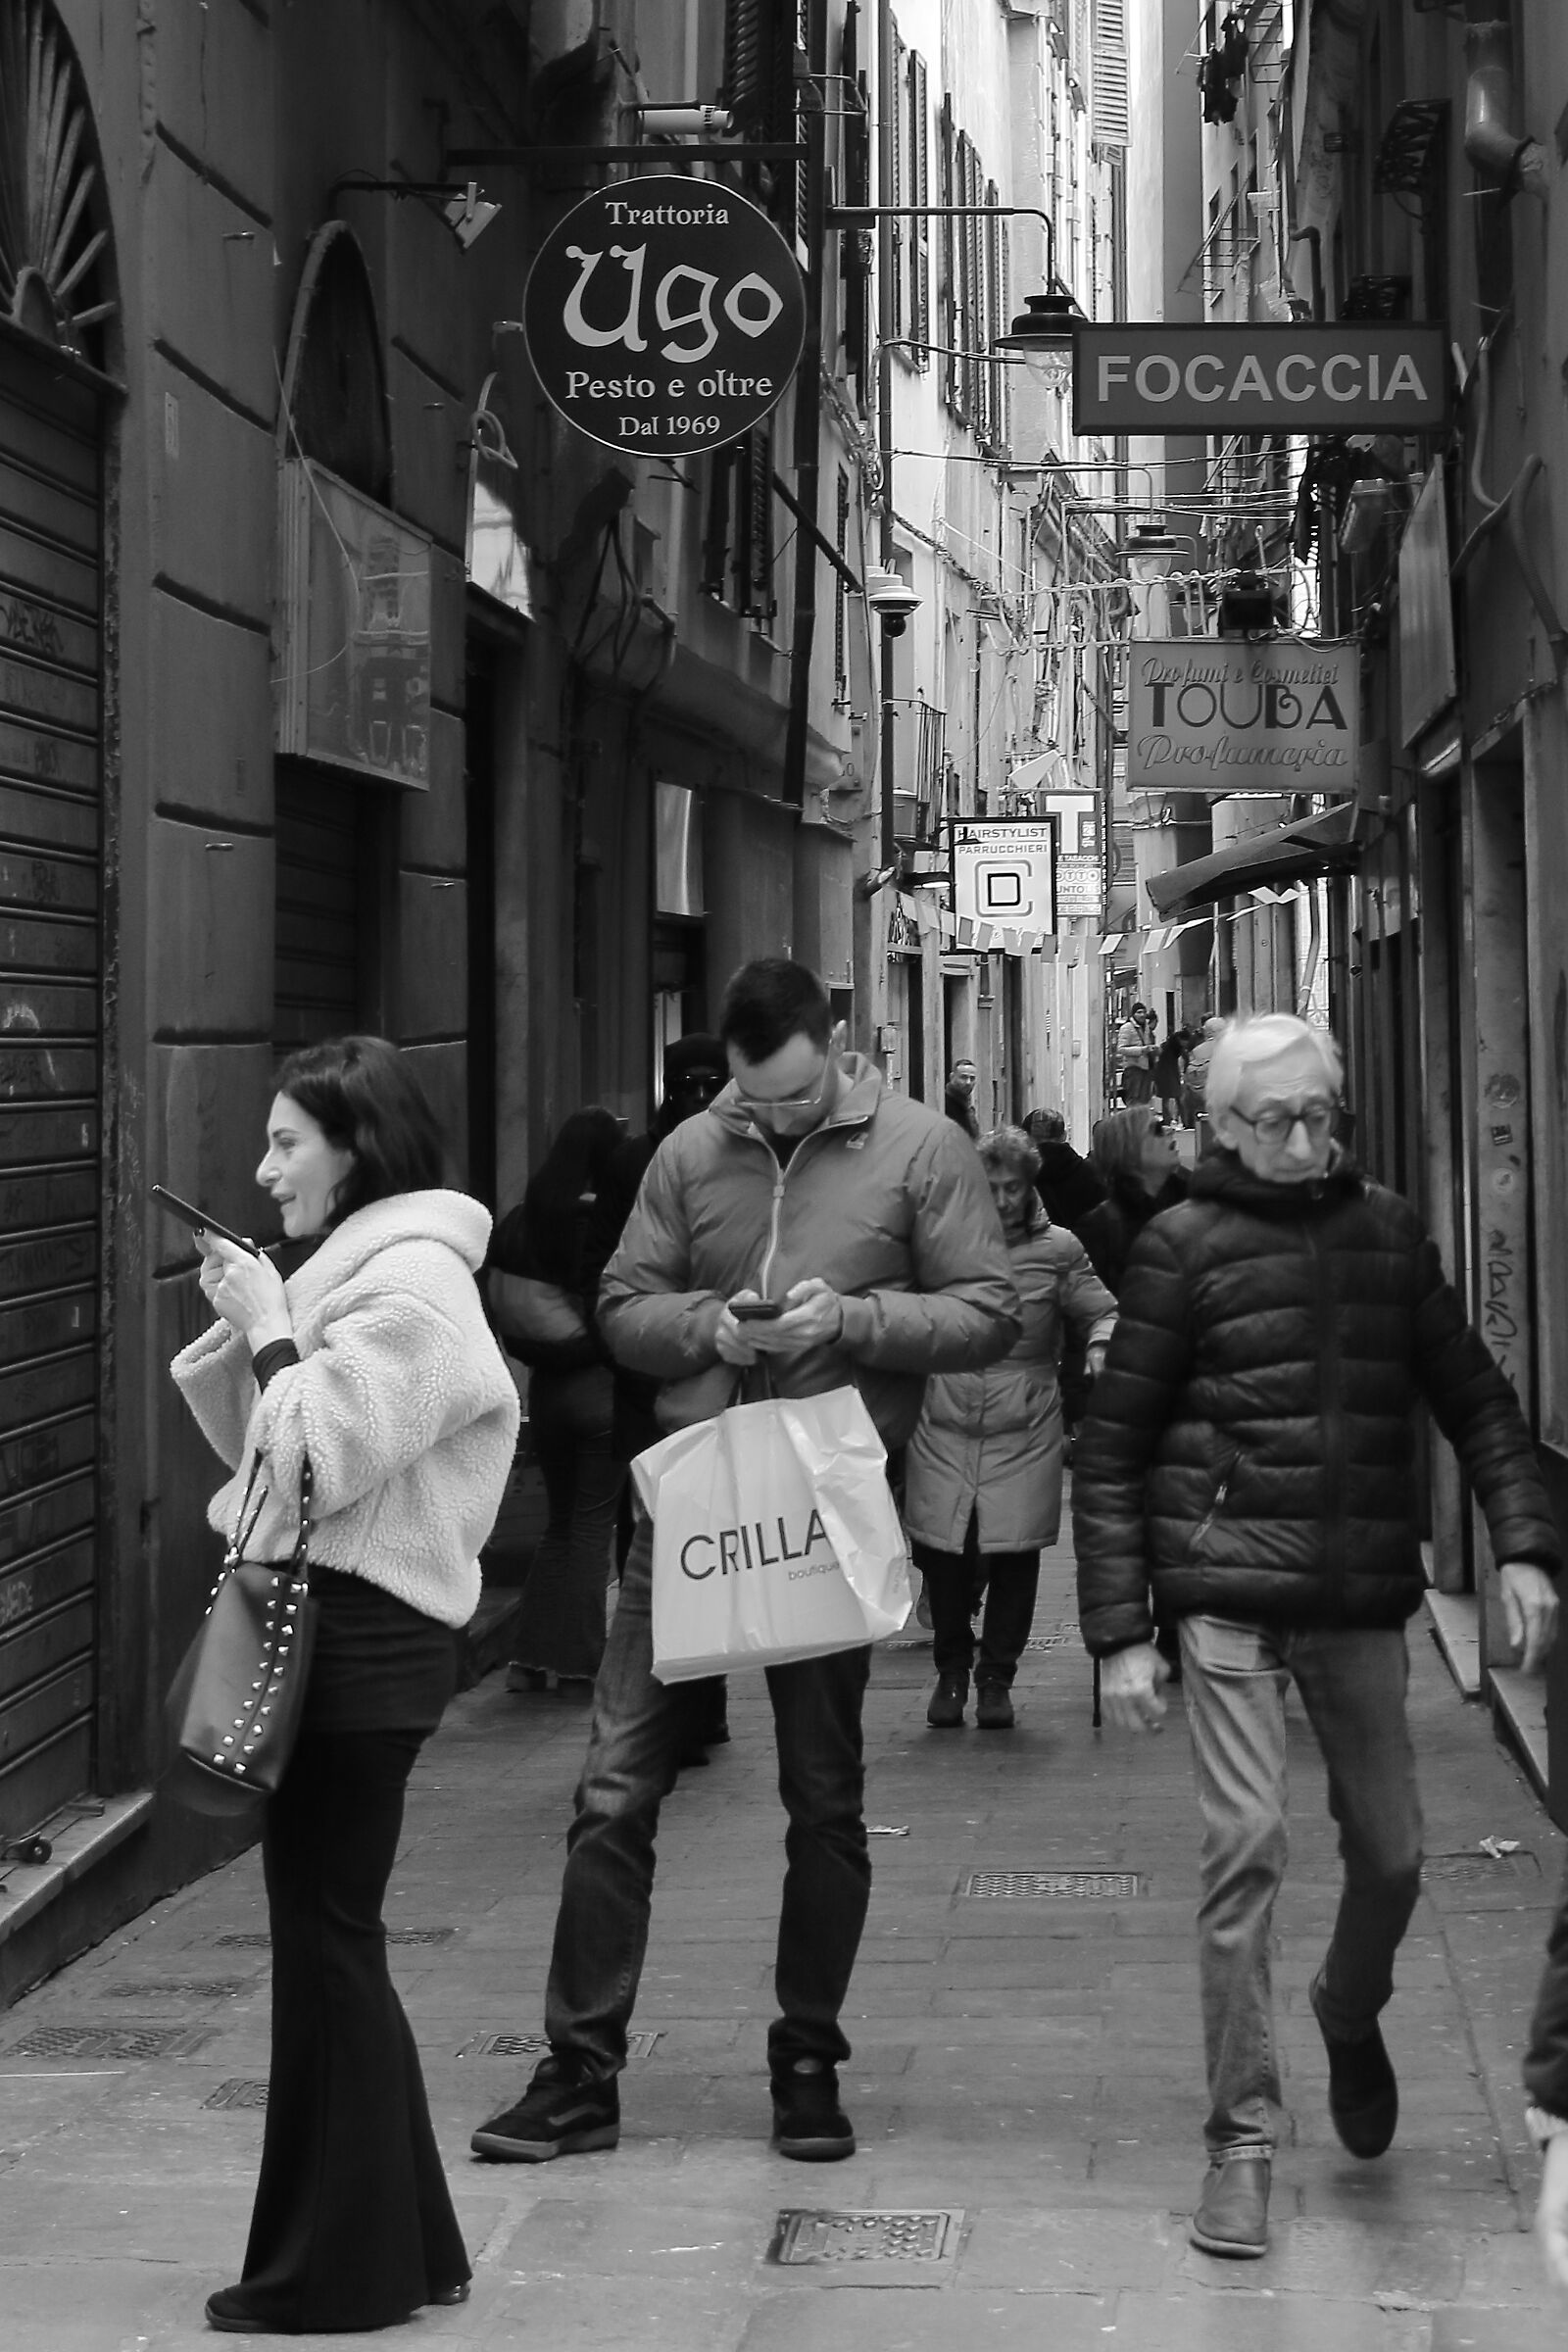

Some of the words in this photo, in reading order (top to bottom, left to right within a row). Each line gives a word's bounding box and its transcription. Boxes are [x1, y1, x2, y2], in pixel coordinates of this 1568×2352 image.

[605, 202, 729, 225] Trattoria
[563, 242, 784, 364] Ugo
[565, 371, 656, 399] Pesto
[668, 377, 685, 398] e
[698, 369, 773, 397] oltre
[1098, 354, 1428, 402] FOCACCIA
[618, 416, 659, 436] Dal
[665, 416, 720, 435] 1969
[1142, 658, 1228, 687] Profumi
[1144, 681, 1348, 730] TOUBA
[1137, 734, 1348, 771] Profumeria
[957, 844, 1048, 855] PARRUCCHIERI
[1056, 869, 1101, 882] OTTO
[1056, 885, 1085, 894] UNTO
